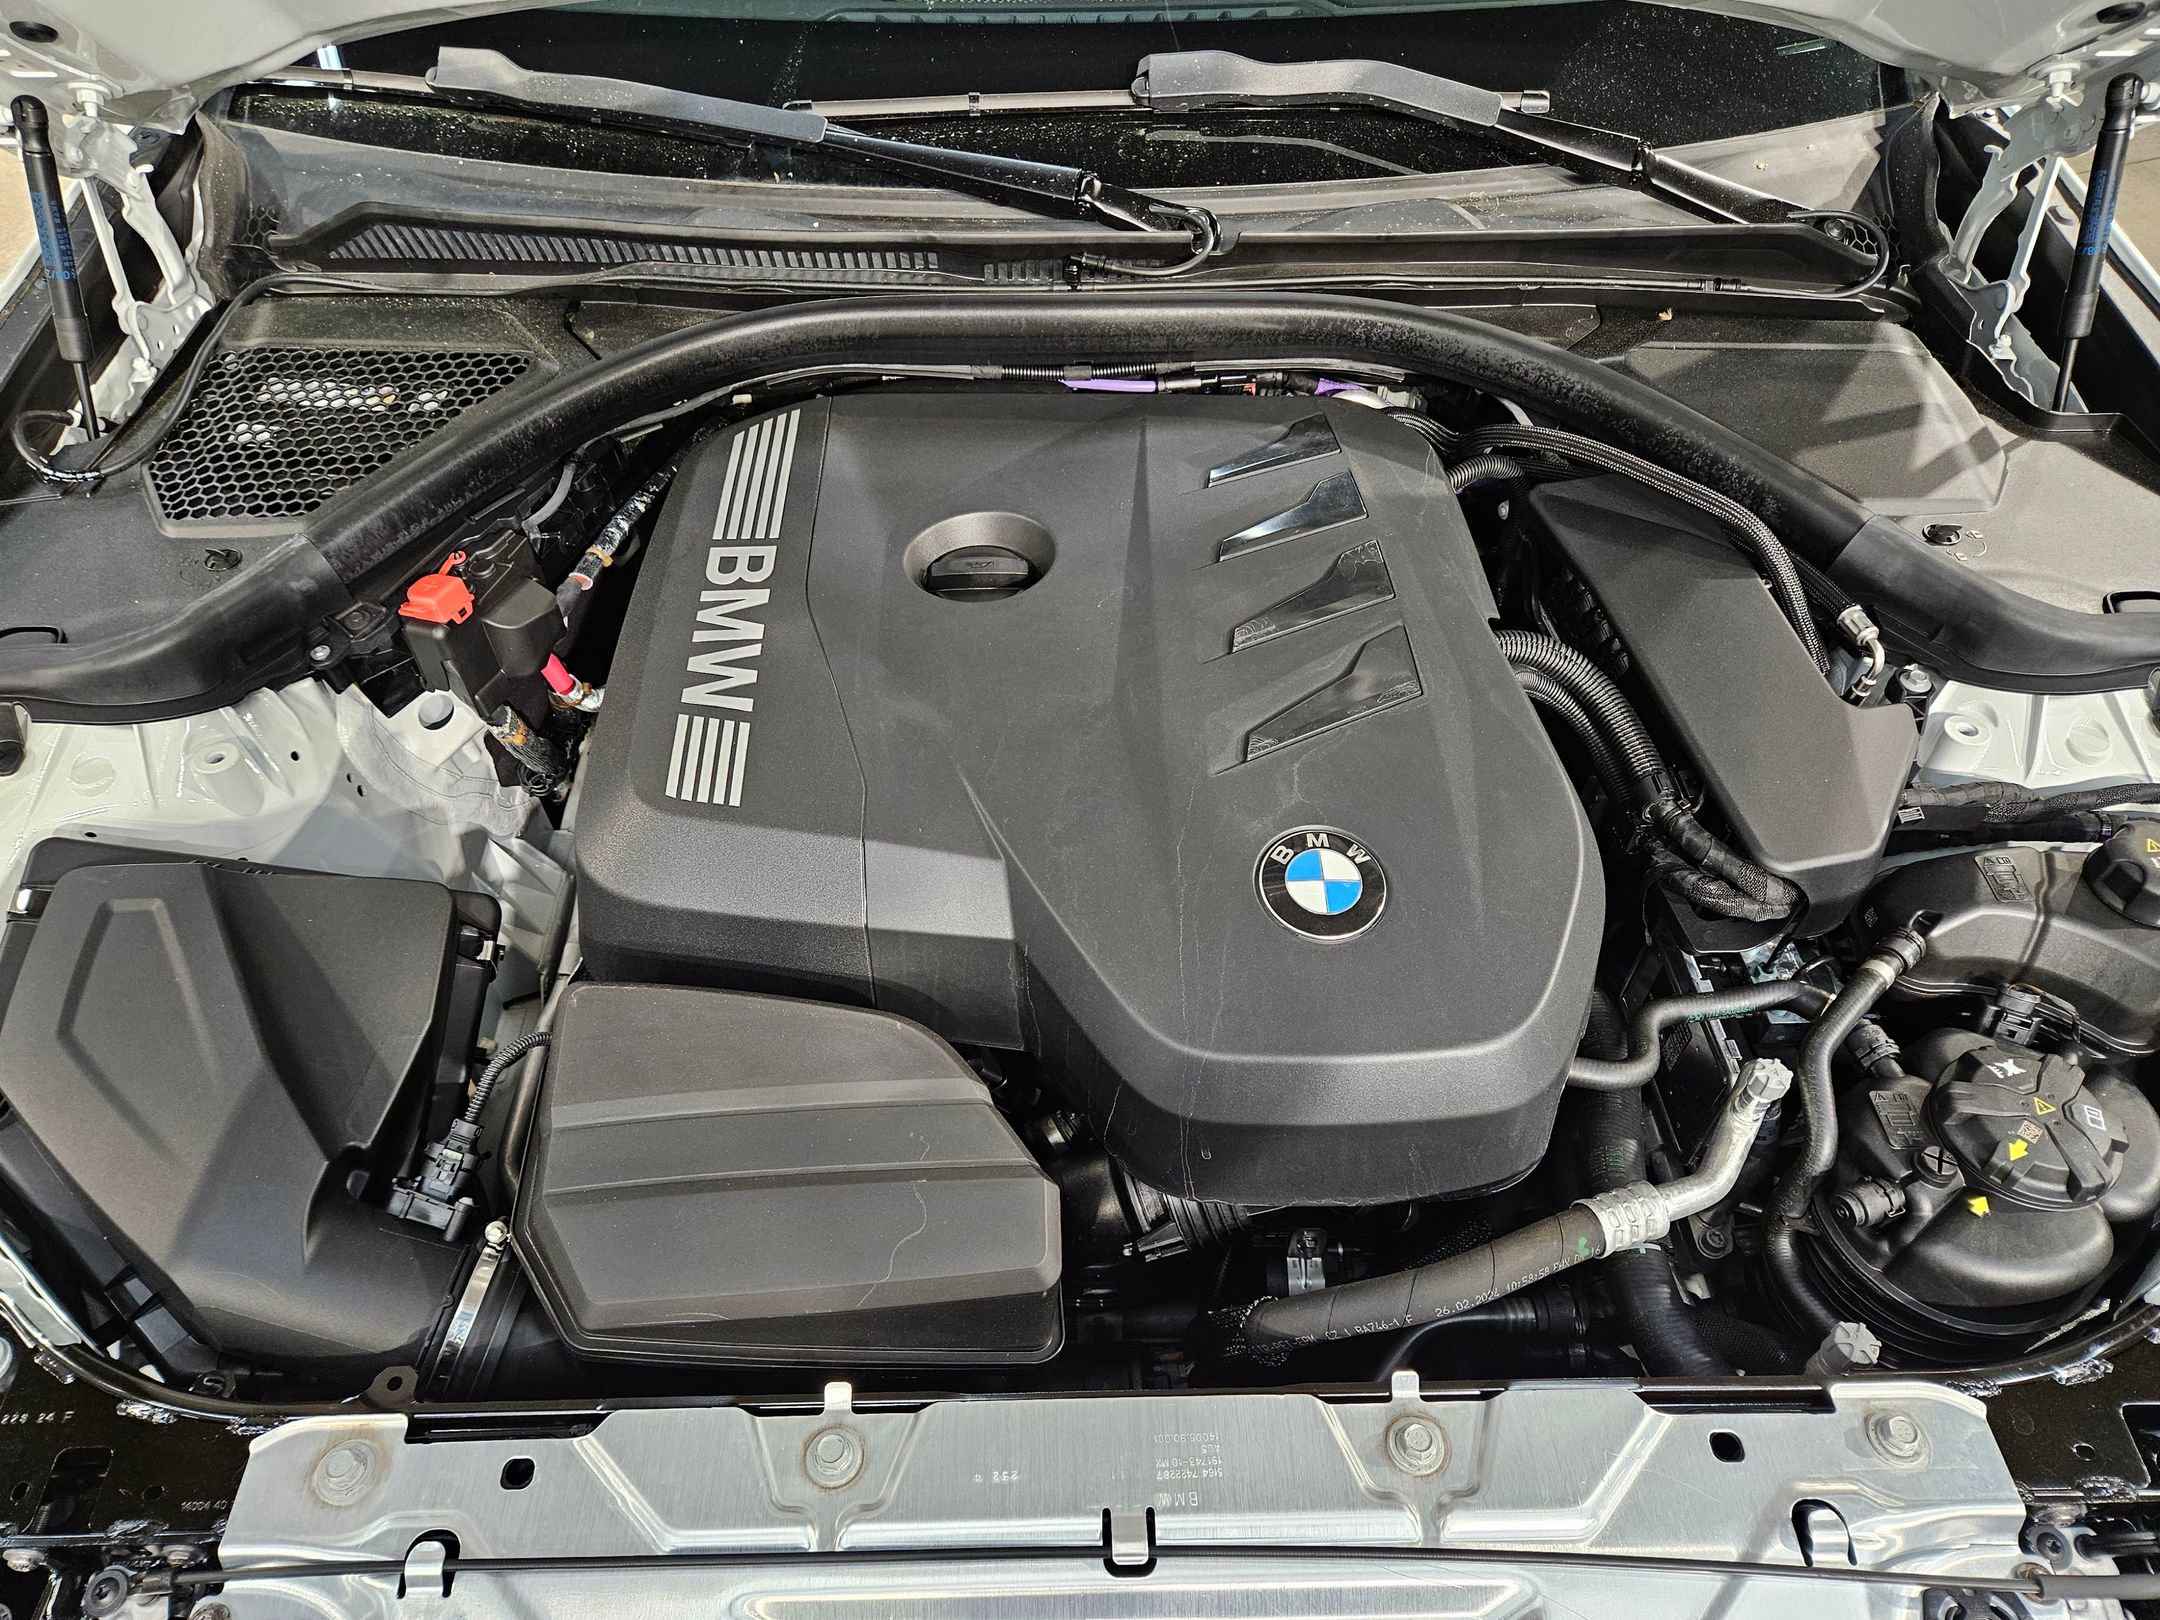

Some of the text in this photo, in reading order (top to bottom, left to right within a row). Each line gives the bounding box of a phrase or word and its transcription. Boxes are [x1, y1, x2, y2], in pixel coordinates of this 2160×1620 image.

[681, 545, 777, 712] BMW
[1270, 832, 1371, 865] BMW
[1158, 1491, 1199, 1507] BMW
